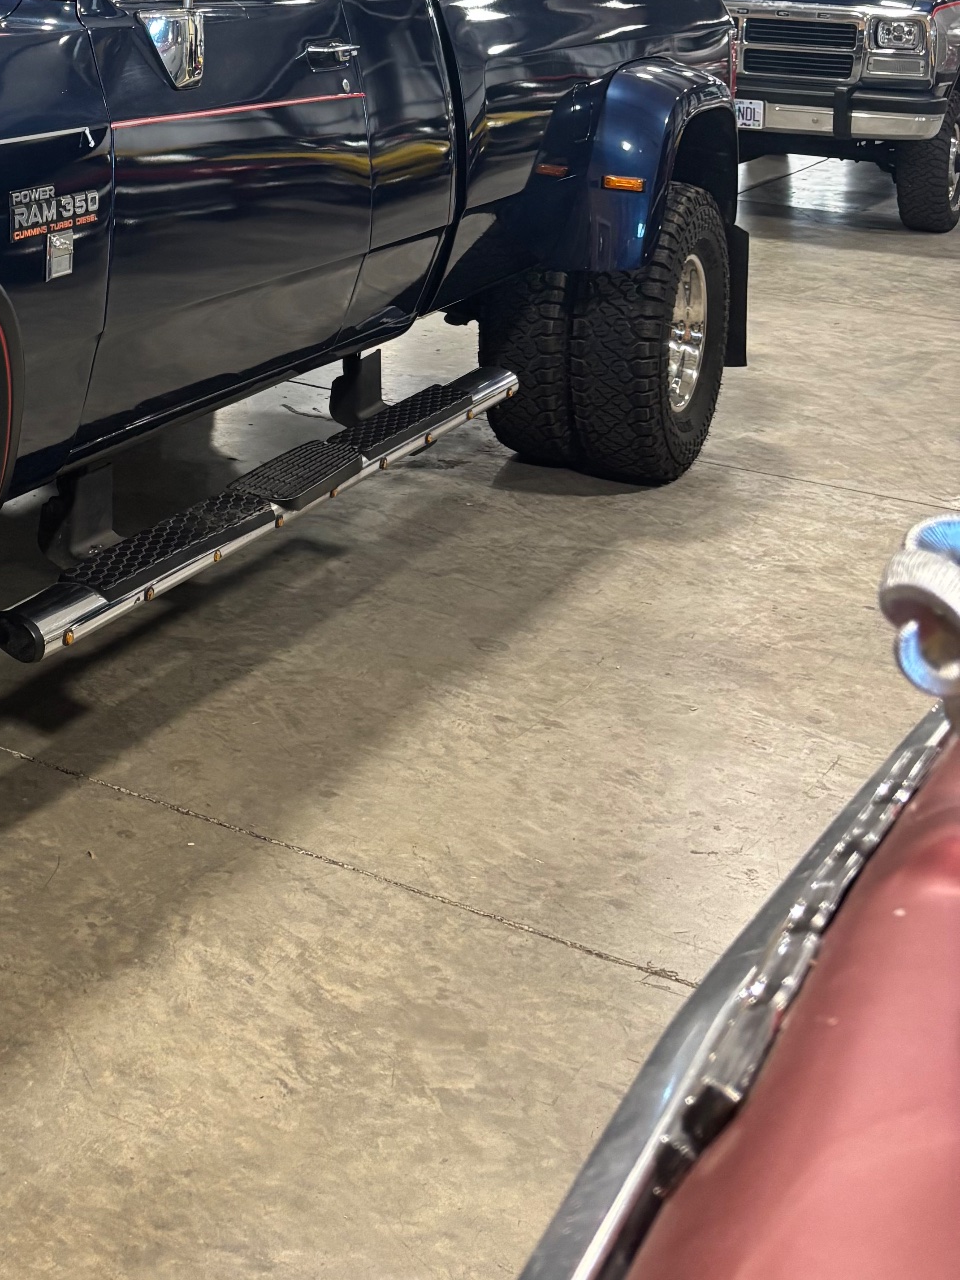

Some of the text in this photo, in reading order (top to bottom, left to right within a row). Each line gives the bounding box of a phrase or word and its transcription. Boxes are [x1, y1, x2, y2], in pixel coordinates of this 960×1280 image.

[12, 185, 55, 206] POWER
[14, 191, 99, 229] RAM 350
[13, 213, 98, 240] CUMMINS TURBO DIESEL
